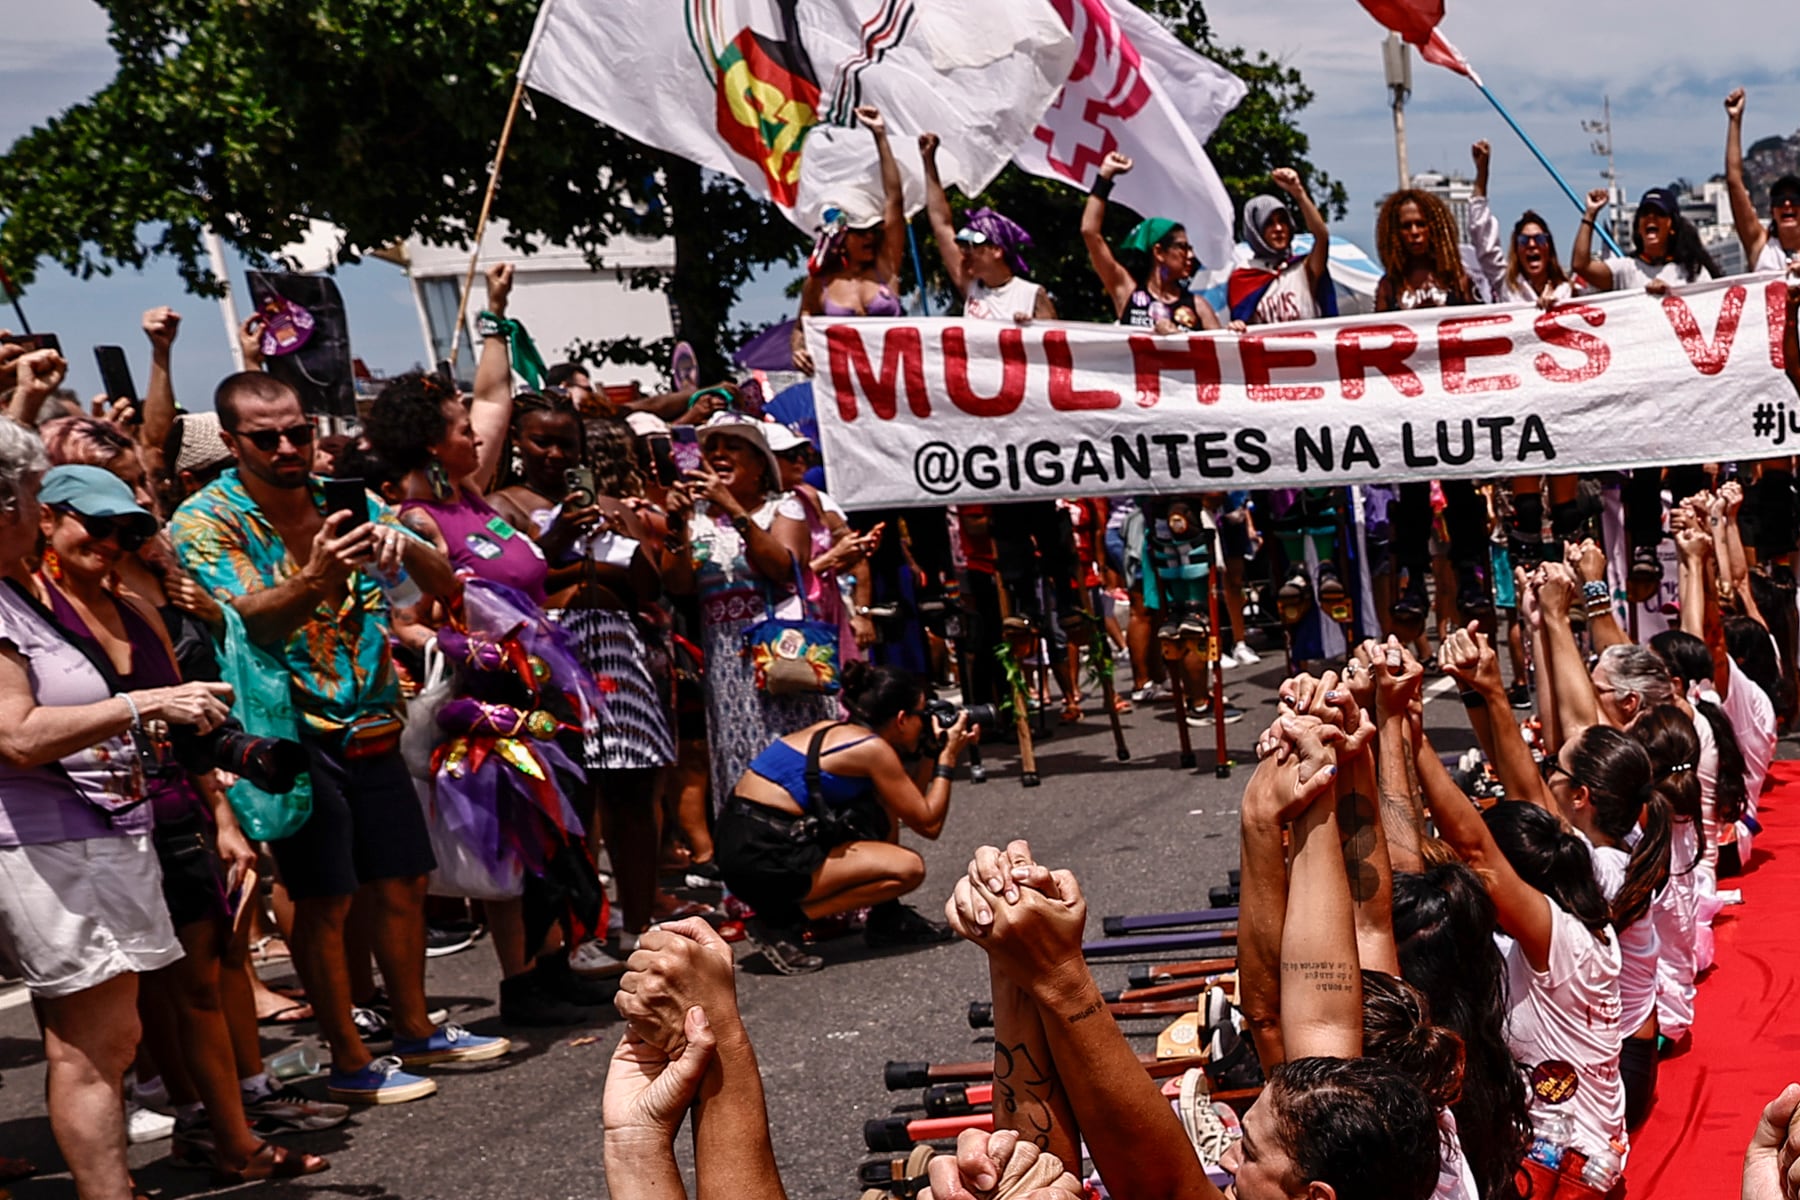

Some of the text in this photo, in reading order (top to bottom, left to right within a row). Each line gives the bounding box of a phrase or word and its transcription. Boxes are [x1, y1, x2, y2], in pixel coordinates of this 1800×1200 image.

[825, 302, 1612, 422] MULHERES
[914, 413, 1557, 496] @GIGANTES NA LUTA
